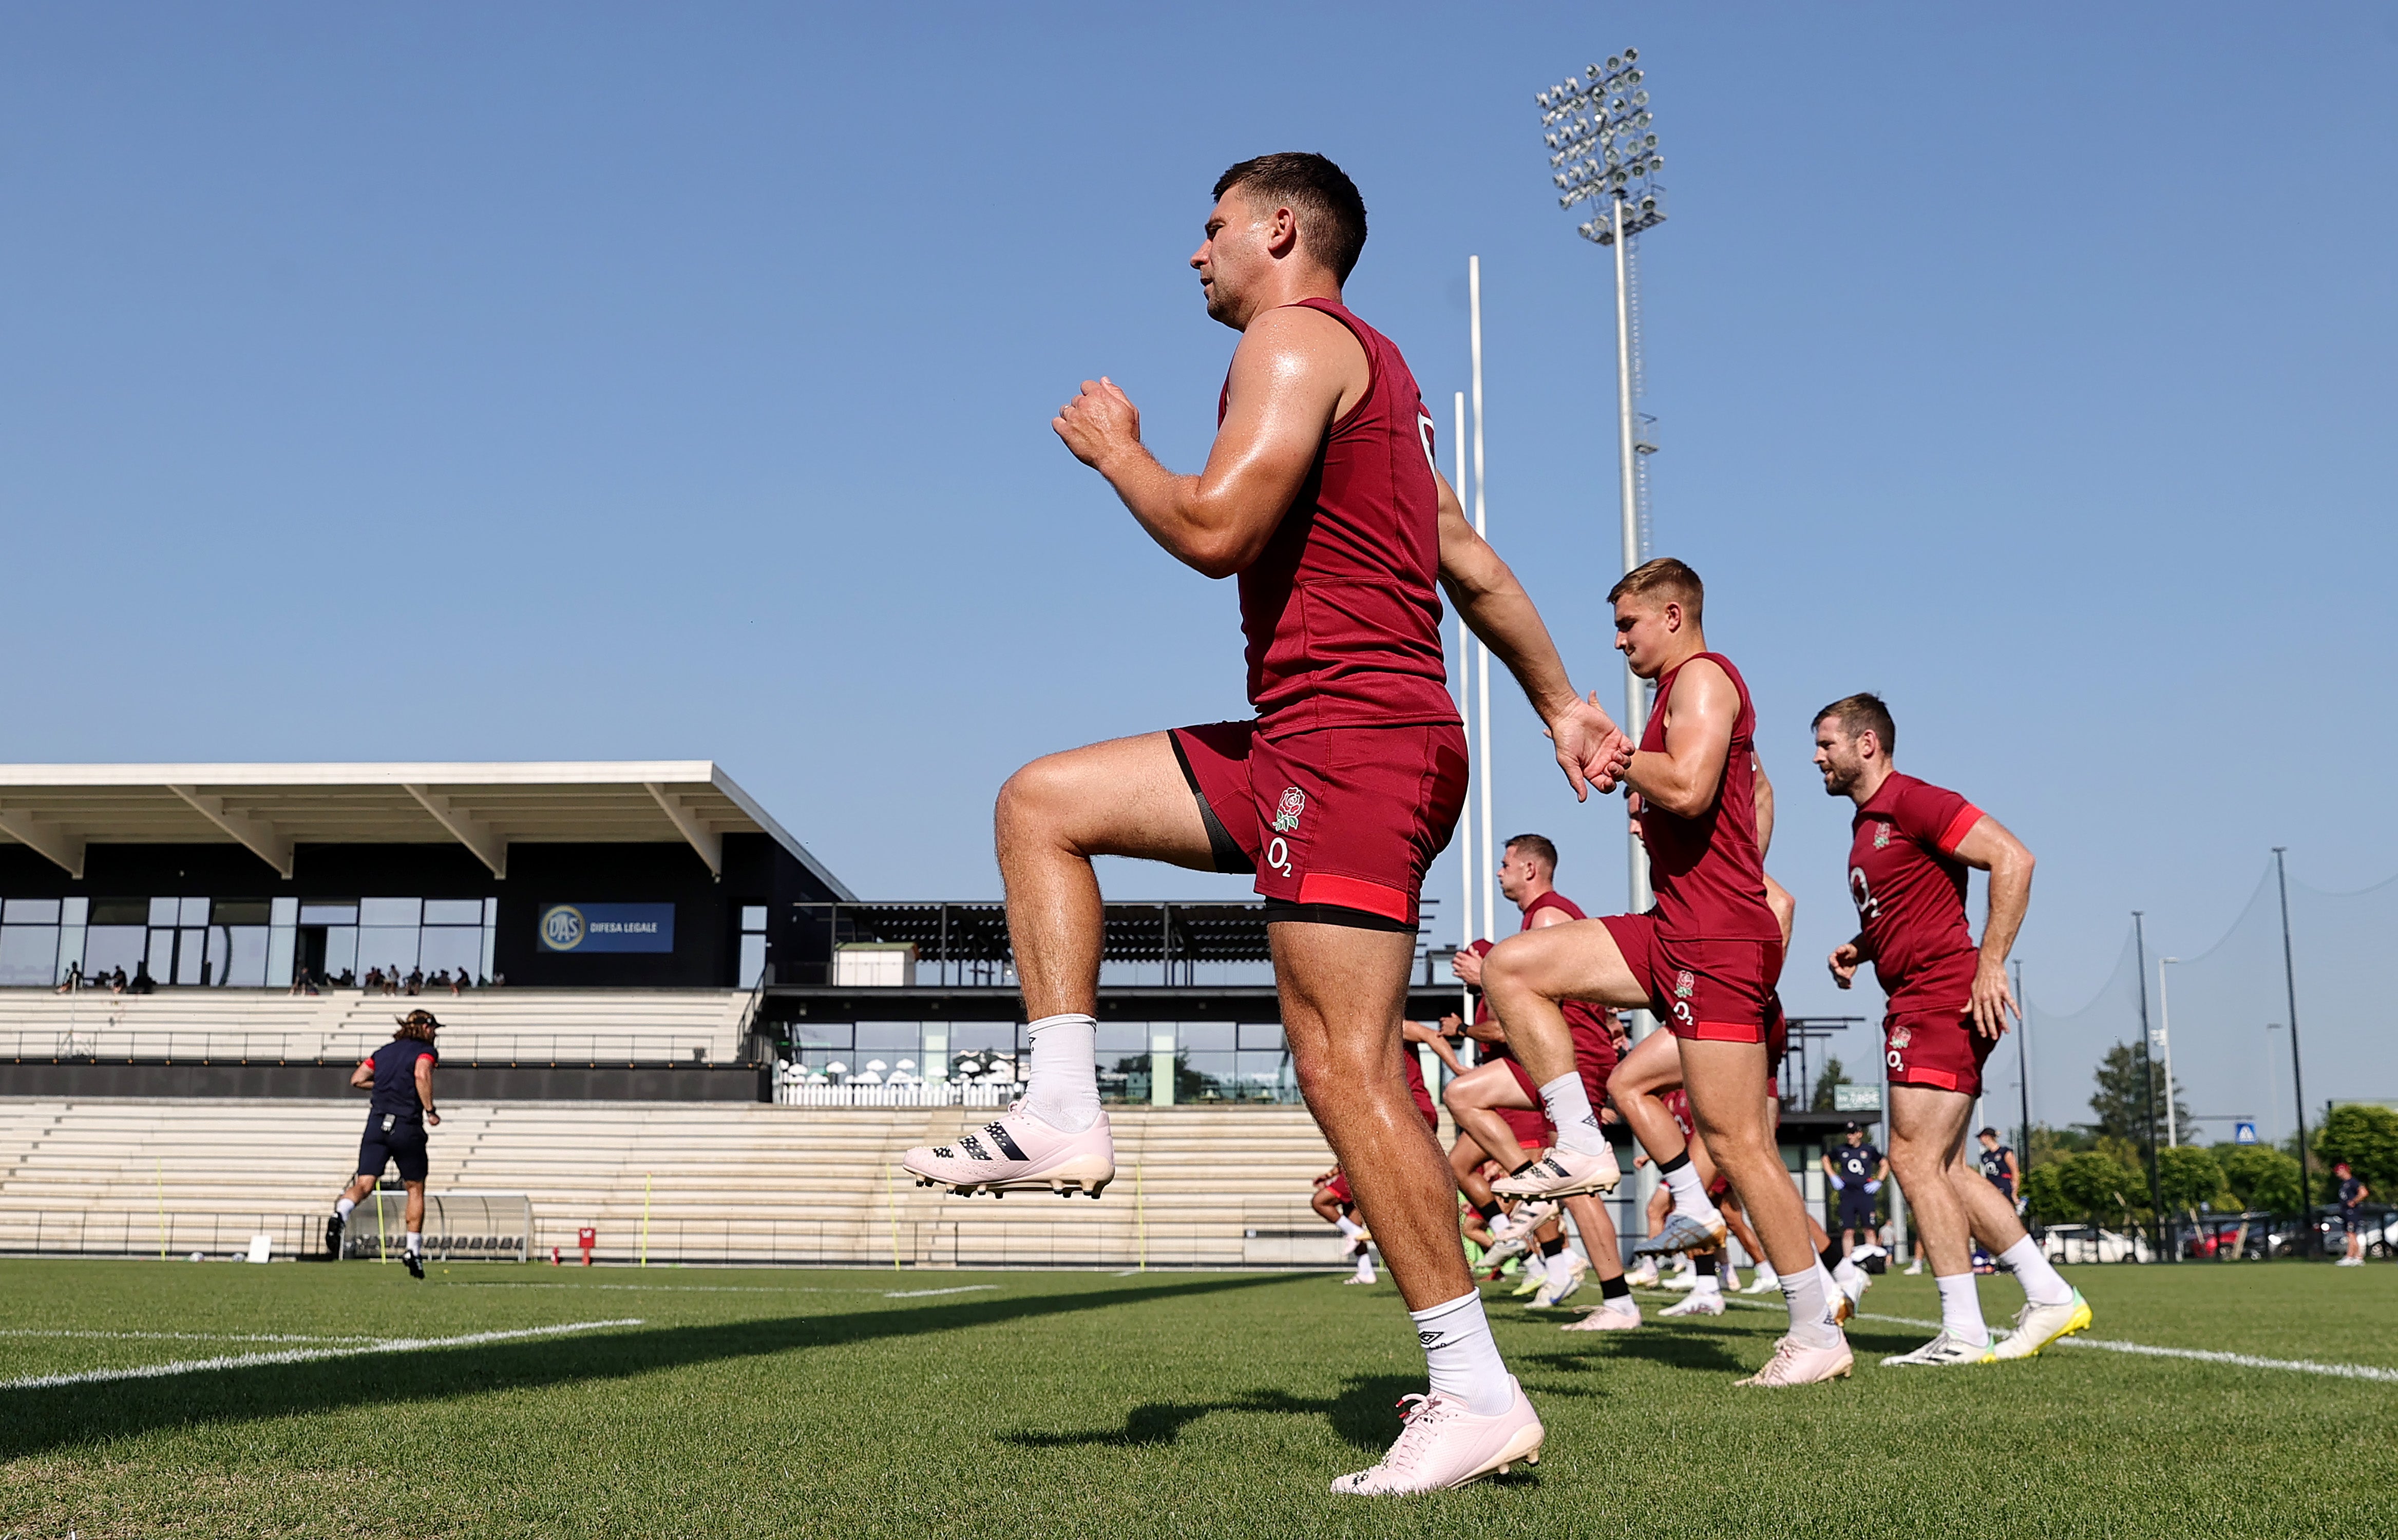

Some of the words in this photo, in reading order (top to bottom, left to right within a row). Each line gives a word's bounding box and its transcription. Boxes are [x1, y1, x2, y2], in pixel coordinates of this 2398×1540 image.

[1267, 837, 1291, 878] O2
[591, 922, 623, 933] DIFESA
[623, 922, 658, 933] LEGALE
[1673, 1001, 1693, 1026] O2
[1887, 1050, 1905, 1072] O2
